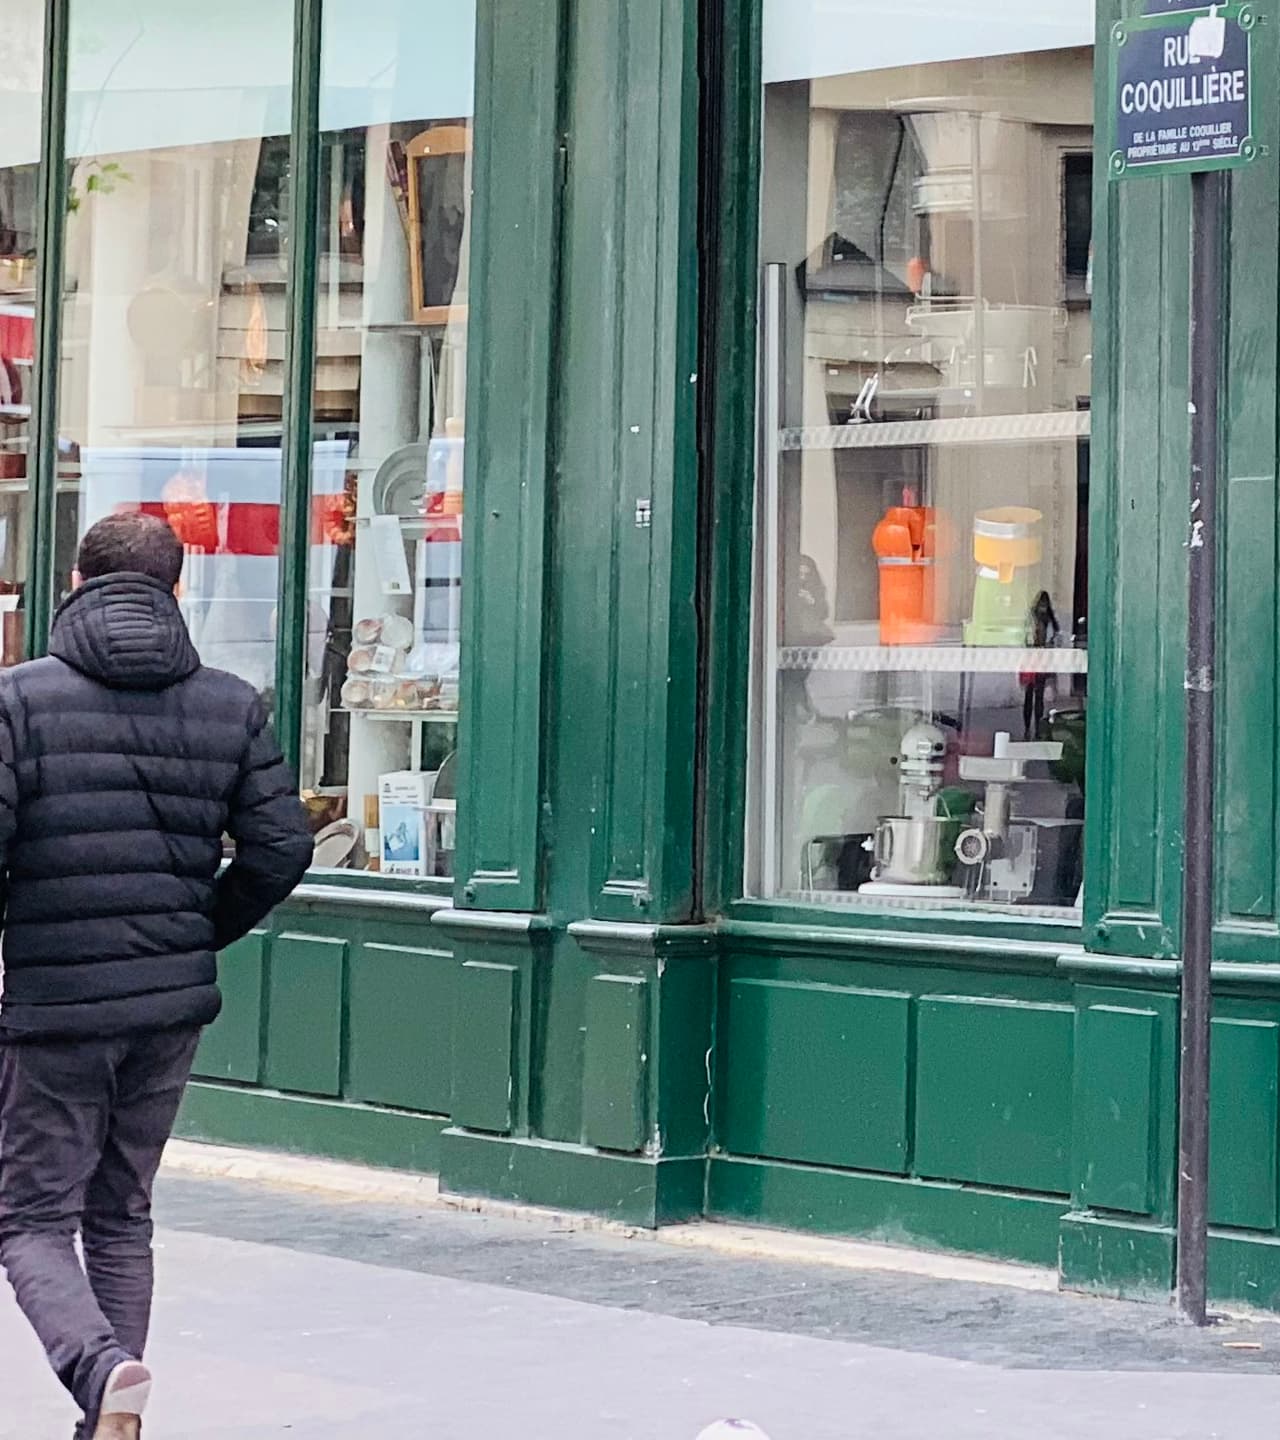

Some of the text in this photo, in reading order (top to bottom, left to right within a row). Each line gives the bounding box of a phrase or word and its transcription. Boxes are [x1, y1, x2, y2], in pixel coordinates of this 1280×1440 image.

[1164, 37, 1201, 67] RU
[1121, 66, 1245, 115] COQUILLIÈRE
[1133, 122, 1232, 144] DE LA FAMILLE COQUILLIER
[1180, 142, 1190, 153] AU
